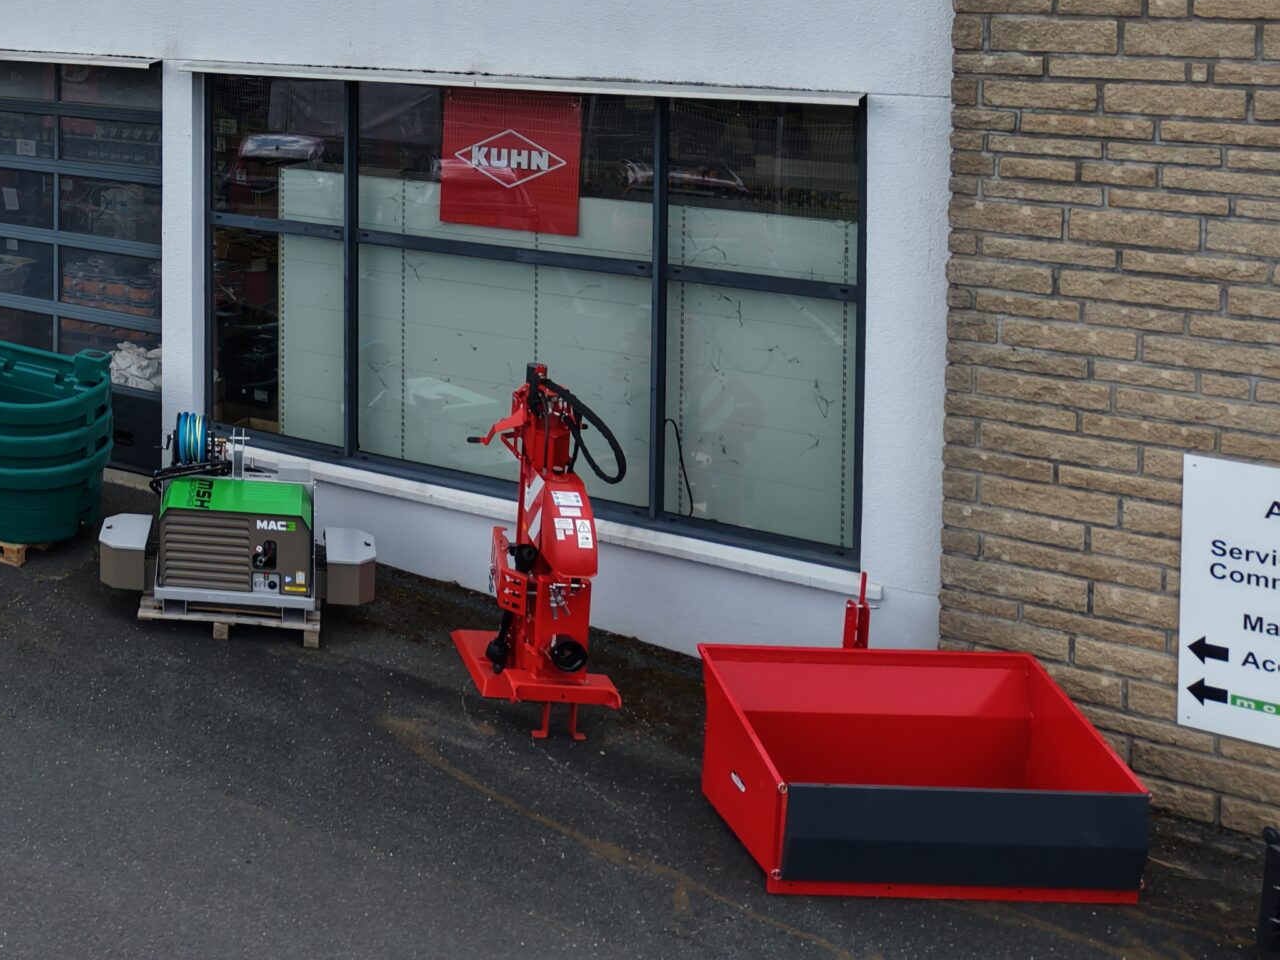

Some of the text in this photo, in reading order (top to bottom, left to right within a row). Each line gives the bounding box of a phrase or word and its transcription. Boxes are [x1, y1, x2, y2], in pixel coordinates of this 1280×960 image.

[471, 145, 549, 171] KUHN
[256, 519, 297, 532] MAC3
[1210, 539, 1280, 567] Servi
[1241, 651, 1280, 673] Ac
